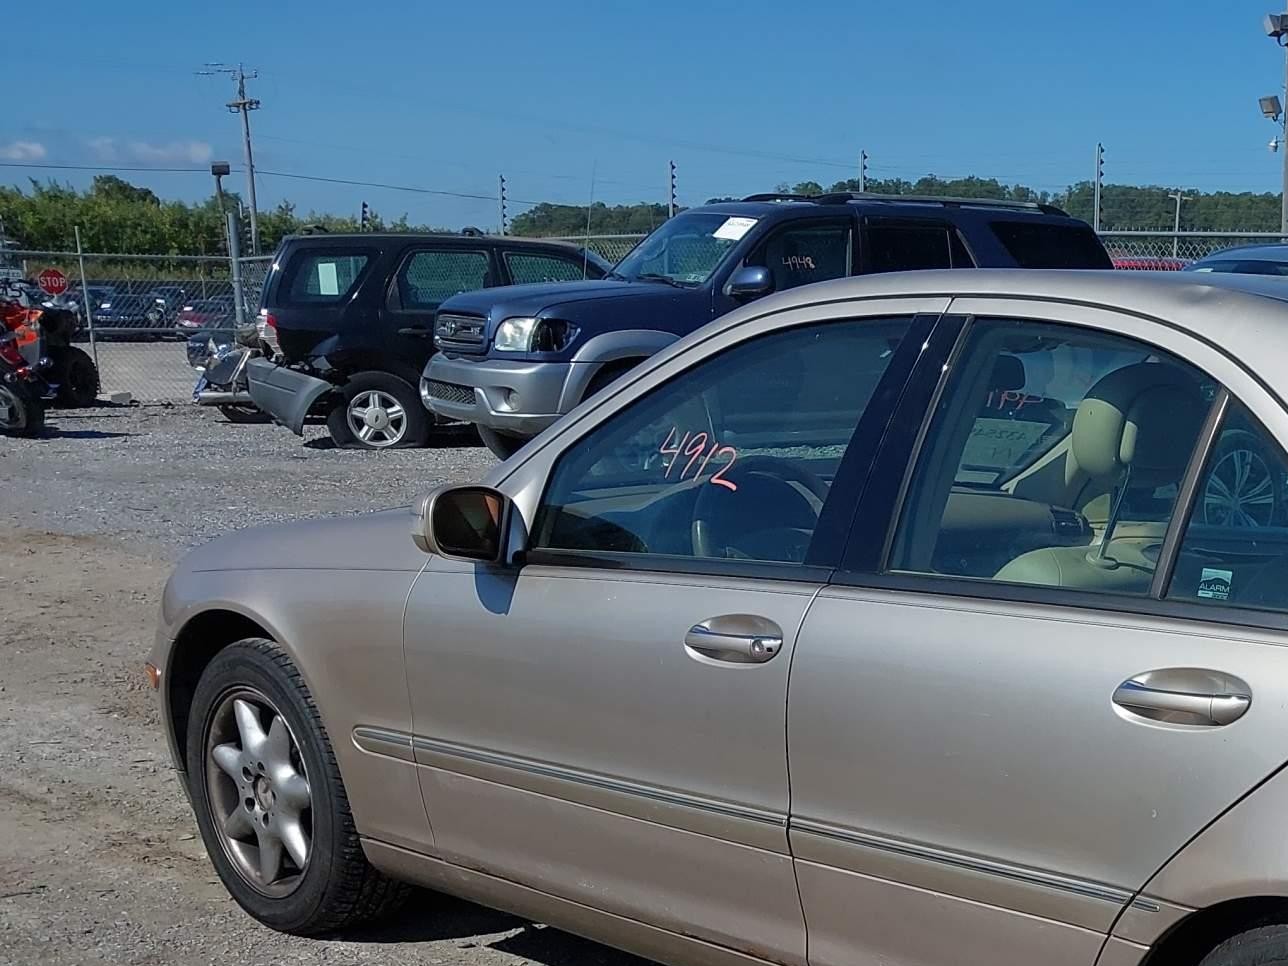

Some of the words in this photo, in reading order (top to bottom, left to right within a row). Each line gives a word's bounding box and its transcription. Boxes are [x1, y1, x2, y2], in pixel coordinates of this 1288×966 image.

[782, 255, 815, 271] 4948
[39, 276, 66, 288] STOP
[660, 426, 737, 491] 4912
[1199, 582, 1230, 593] ALARM
